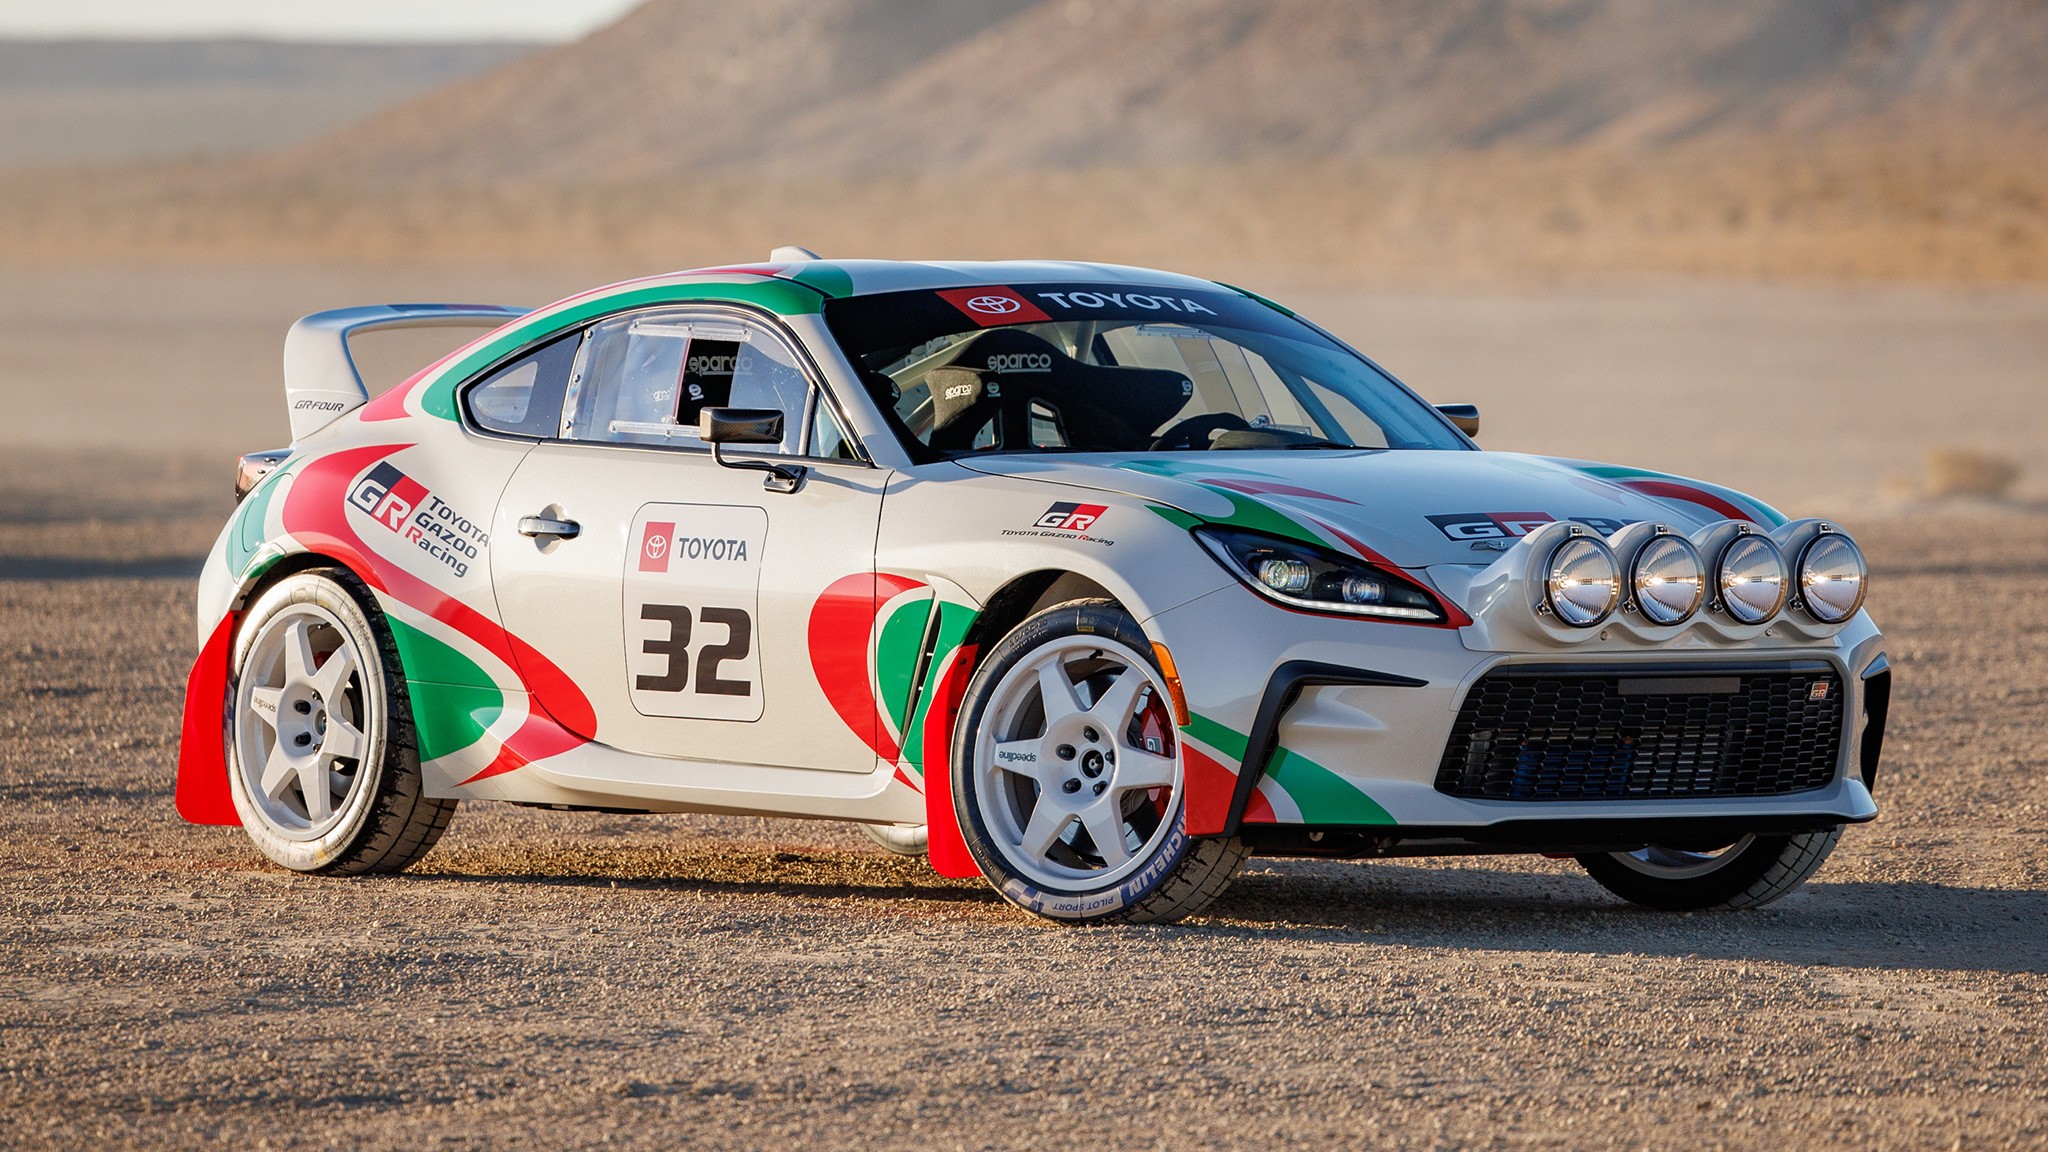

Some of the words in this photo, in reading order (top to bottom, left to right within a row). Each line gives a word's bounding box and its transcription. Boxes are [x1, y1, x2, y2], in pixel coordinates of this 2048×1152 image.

[1037, 291, 1218, 316] TOYOTA
[688, 355, 753, 377] sparco
[987, 353, 1052, 374] sparco
[945, 384, 972, 399] sparco
[294, 400, 345, 412] GR-FOUR
[351, 478, 412, 533] GR
[429, 495, 490, 547] TOYOTA
[1037, 512, 1096, 530] GR
[415, 512, 478, 560] GAZOO
[1001, 529, 1038, 537] TOYOTA
[1039, 531, 1077, 540] GAZOO
[1077, 534, 1115, 546] Racing
[405, 525, 469, 579] Racing
[678, 537, 747, 561] TOYOTA
[636, 603, 751, 697] 32
[999, 751, 1037, 762] speedline
[1052, 902, 1084, 912] SPORT
[1087, 896, 1114, 911] PILOT
